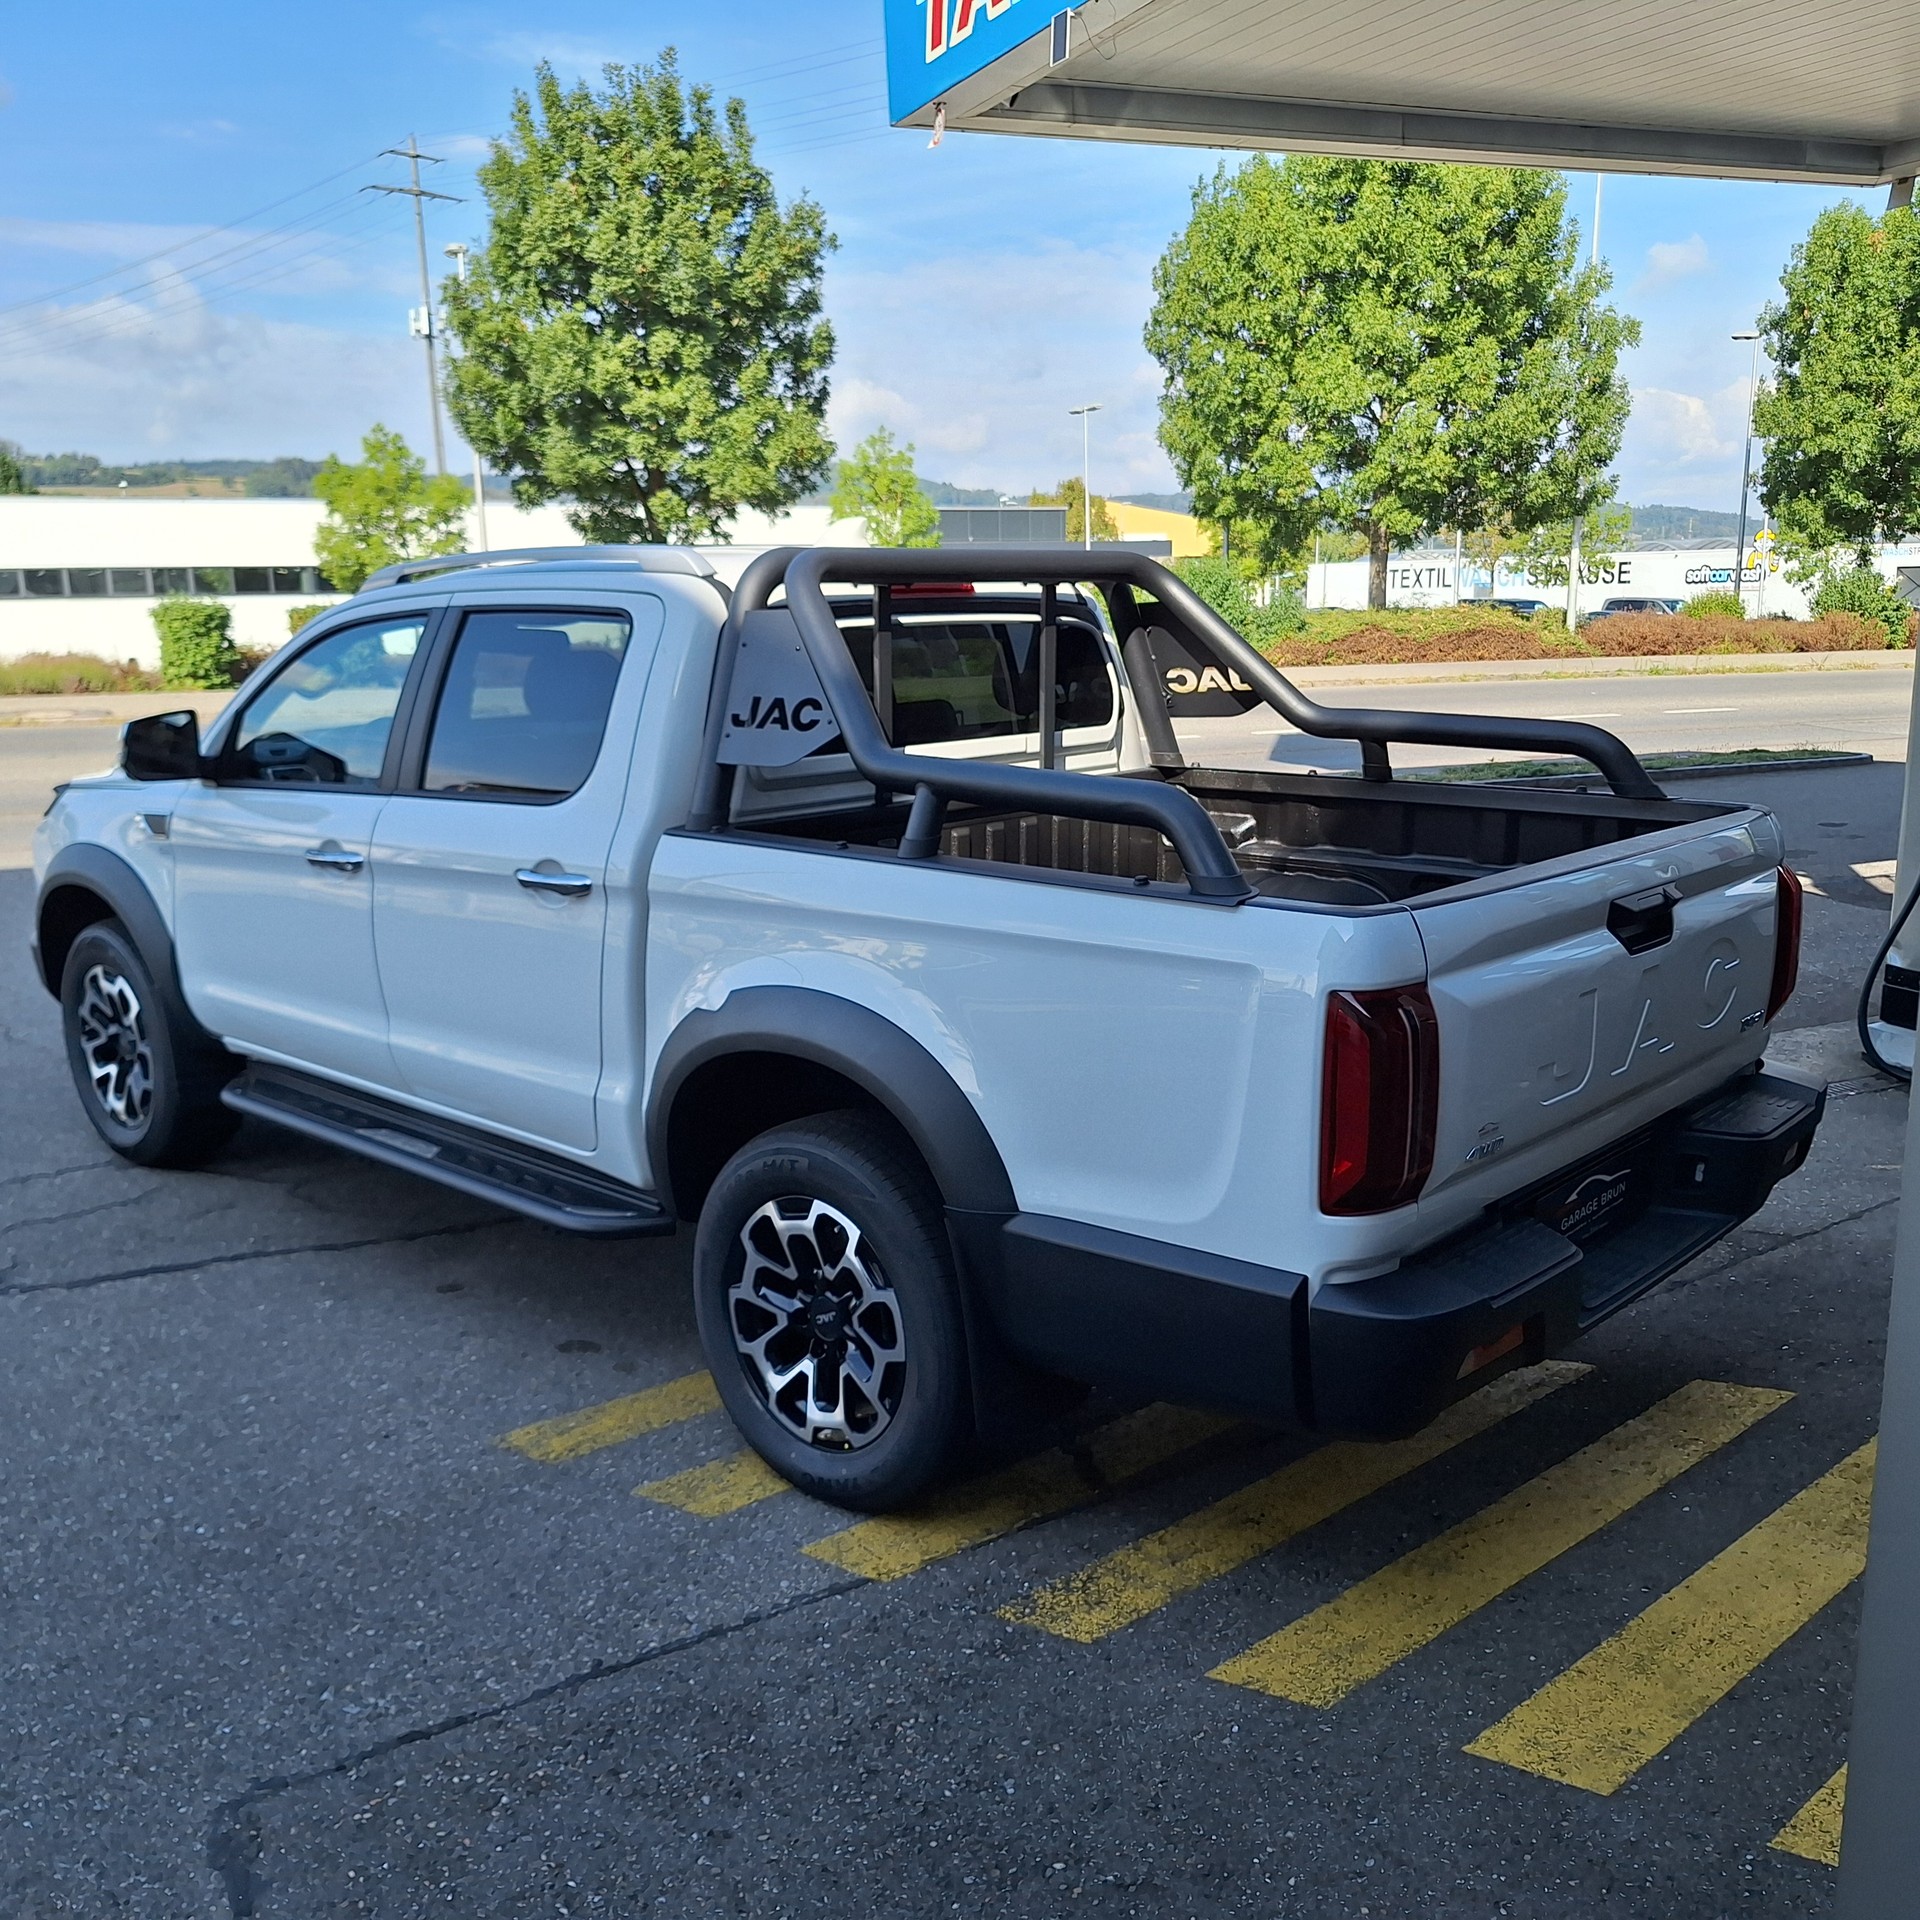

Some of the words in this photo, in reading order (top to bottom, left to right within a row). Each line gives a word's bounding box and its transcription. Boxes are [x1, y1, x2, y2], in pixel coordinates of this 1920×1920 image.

[731, 696, 823, 732] JAC
[1536, 938, 1741, 1107] JAC
[1561, 1197, 1598, 1231] GARAGE
[1601, 1180, 1626, 1206] BRUN
